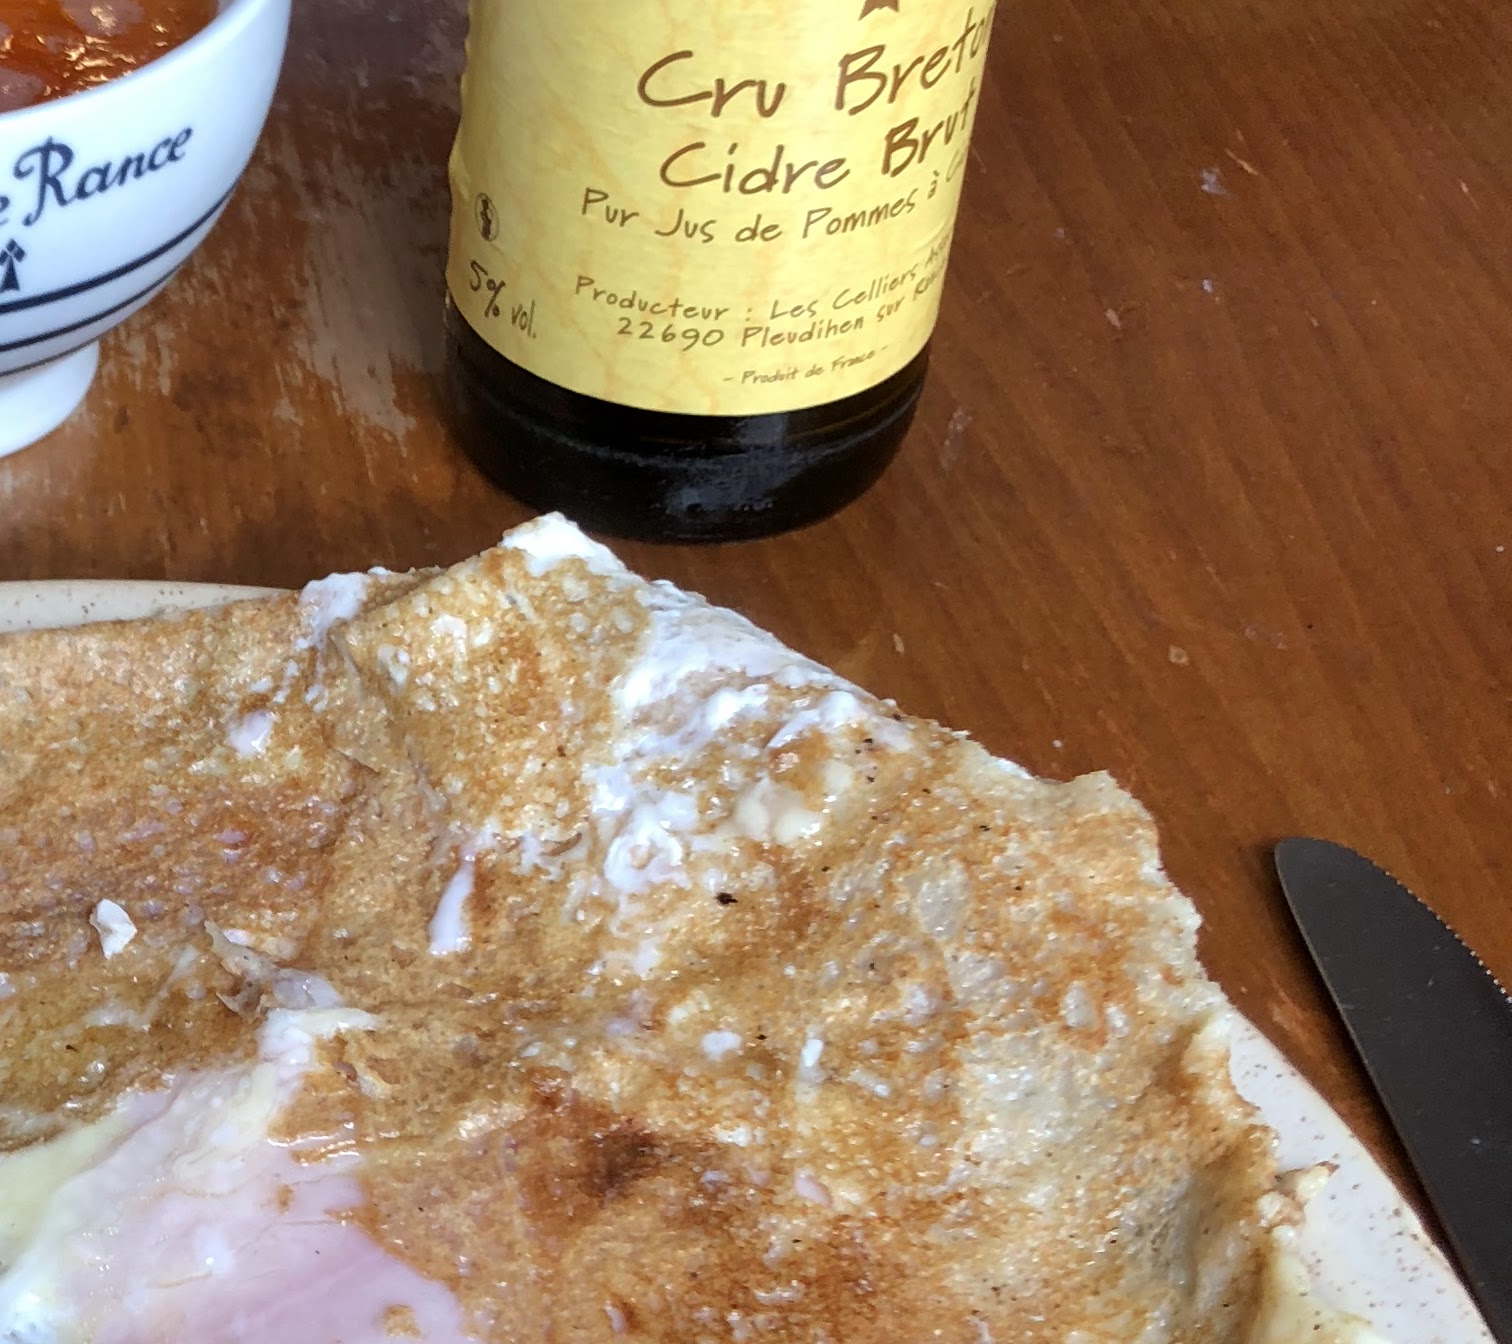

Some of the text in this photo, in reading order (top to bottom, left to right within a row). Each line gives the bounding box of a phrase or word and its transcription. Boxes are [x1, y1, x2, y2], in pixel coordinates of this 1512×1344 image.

[637, 4, 992, 118] Cru Breto
[659, 141, 851, 195] Cidre
[881, 76, 976, 178] Brut
[12, 126, 194, 228] Rance
[580, 186, 640, 227] Pur
[654, 208, 717, 244] Jus
[735, 213, 783, 243] de
[802, 187, 919, 239] Pommes
[575, 274, 730, 322] Producteur
[769, 299, 819, 321] Les
[831, 262, 920, 311] Celliers
[616, 296, 906, 352] 22690 Pleudihen sur
[741, 366, 801, 385] Produit
[804, 363, 826, 379] de
[830, 349, 876, 372] France
